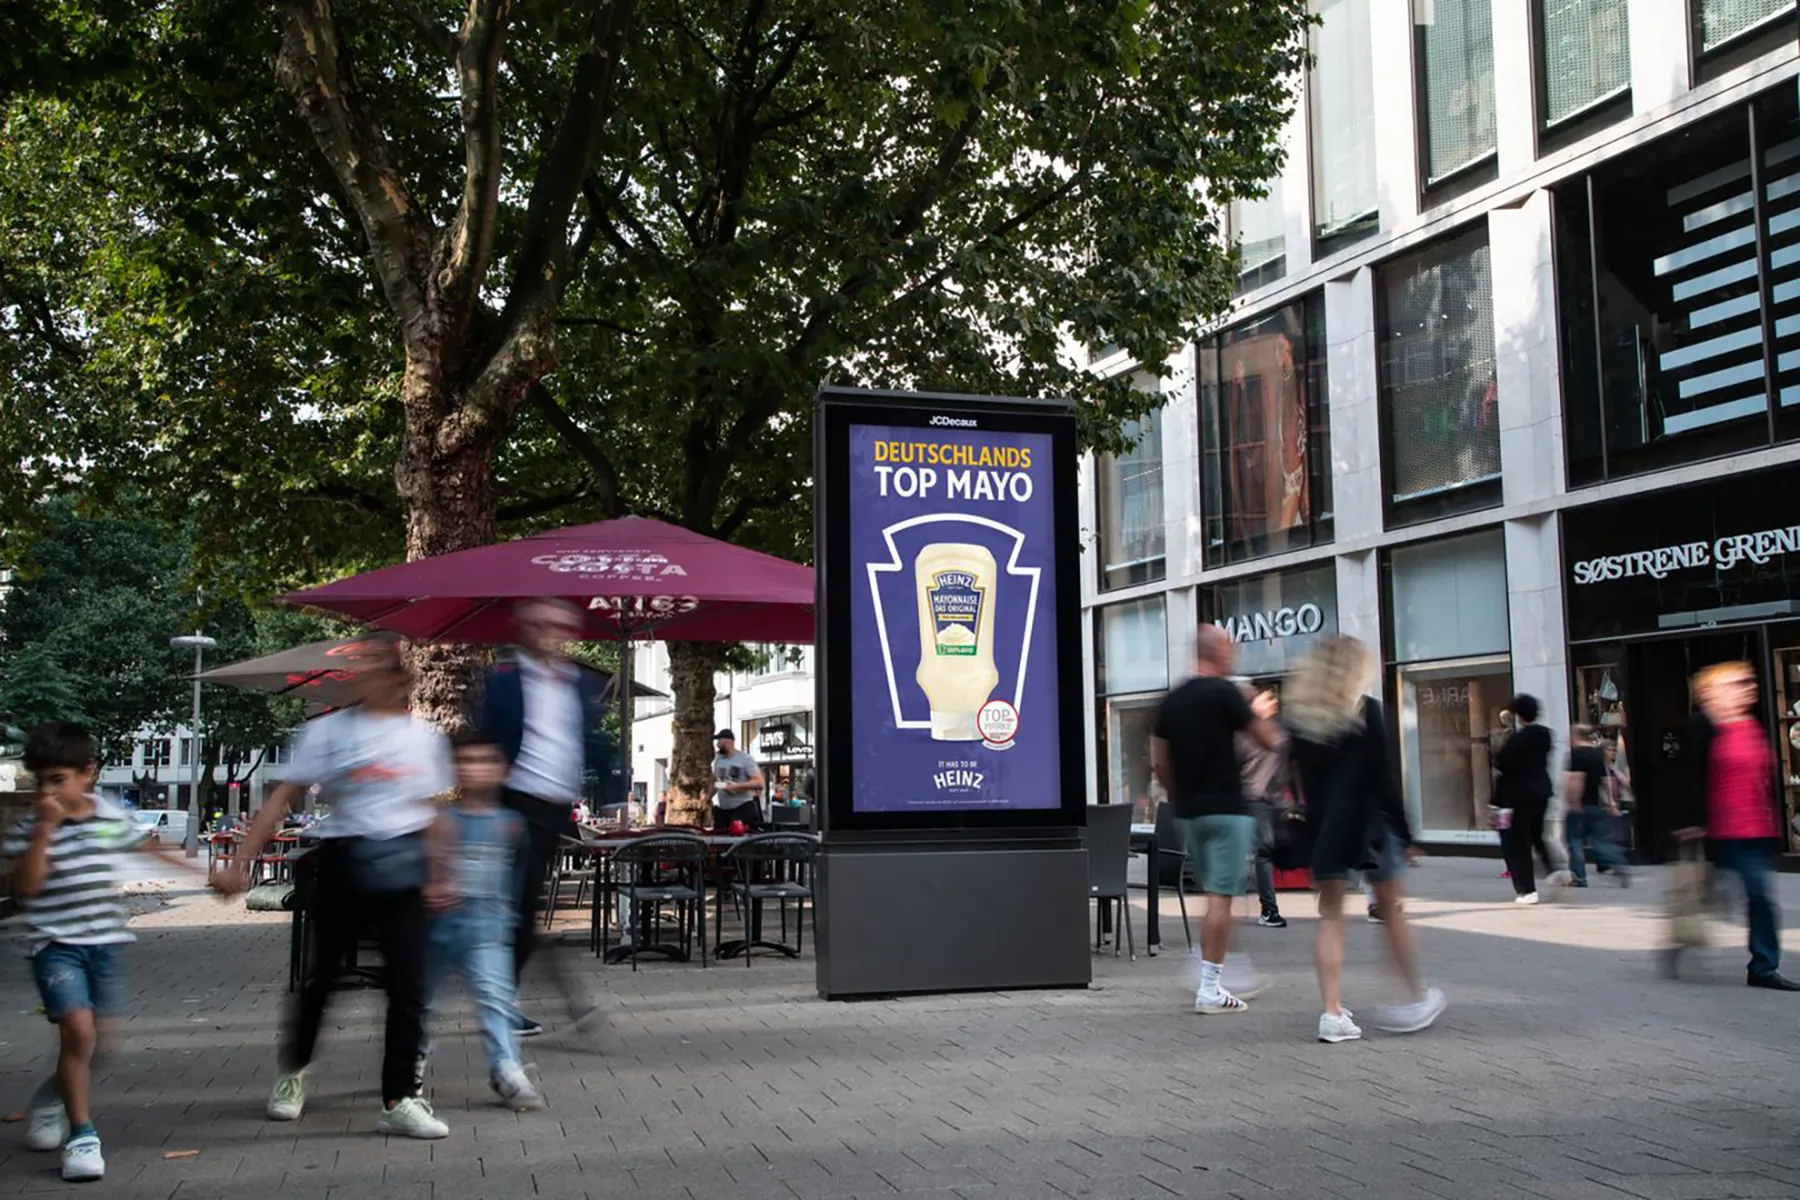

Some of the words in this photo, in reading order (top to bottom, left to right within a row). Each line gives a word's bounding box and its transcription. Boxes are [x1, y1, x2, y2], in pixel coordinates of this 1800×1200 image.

[929, 415, 978, 427] JCDecaux
[874, 440, 1032, 468] DEUTSCHLANDS
[873, 465, 937, 498] TOP
[947, 469, 1033, 502] MAYO
[1573, 541, 1710, 584] SØSTRENE
[939, 574, 972, 588] HEINZ
[1215, 603, 1323, 644] MANGO
[983, 708, 1010, 722] TOP
[946, 760, 959, 768] HAS
[960, 760, 969, 768] TO
[933, 769, 984, 789] HEINZ
